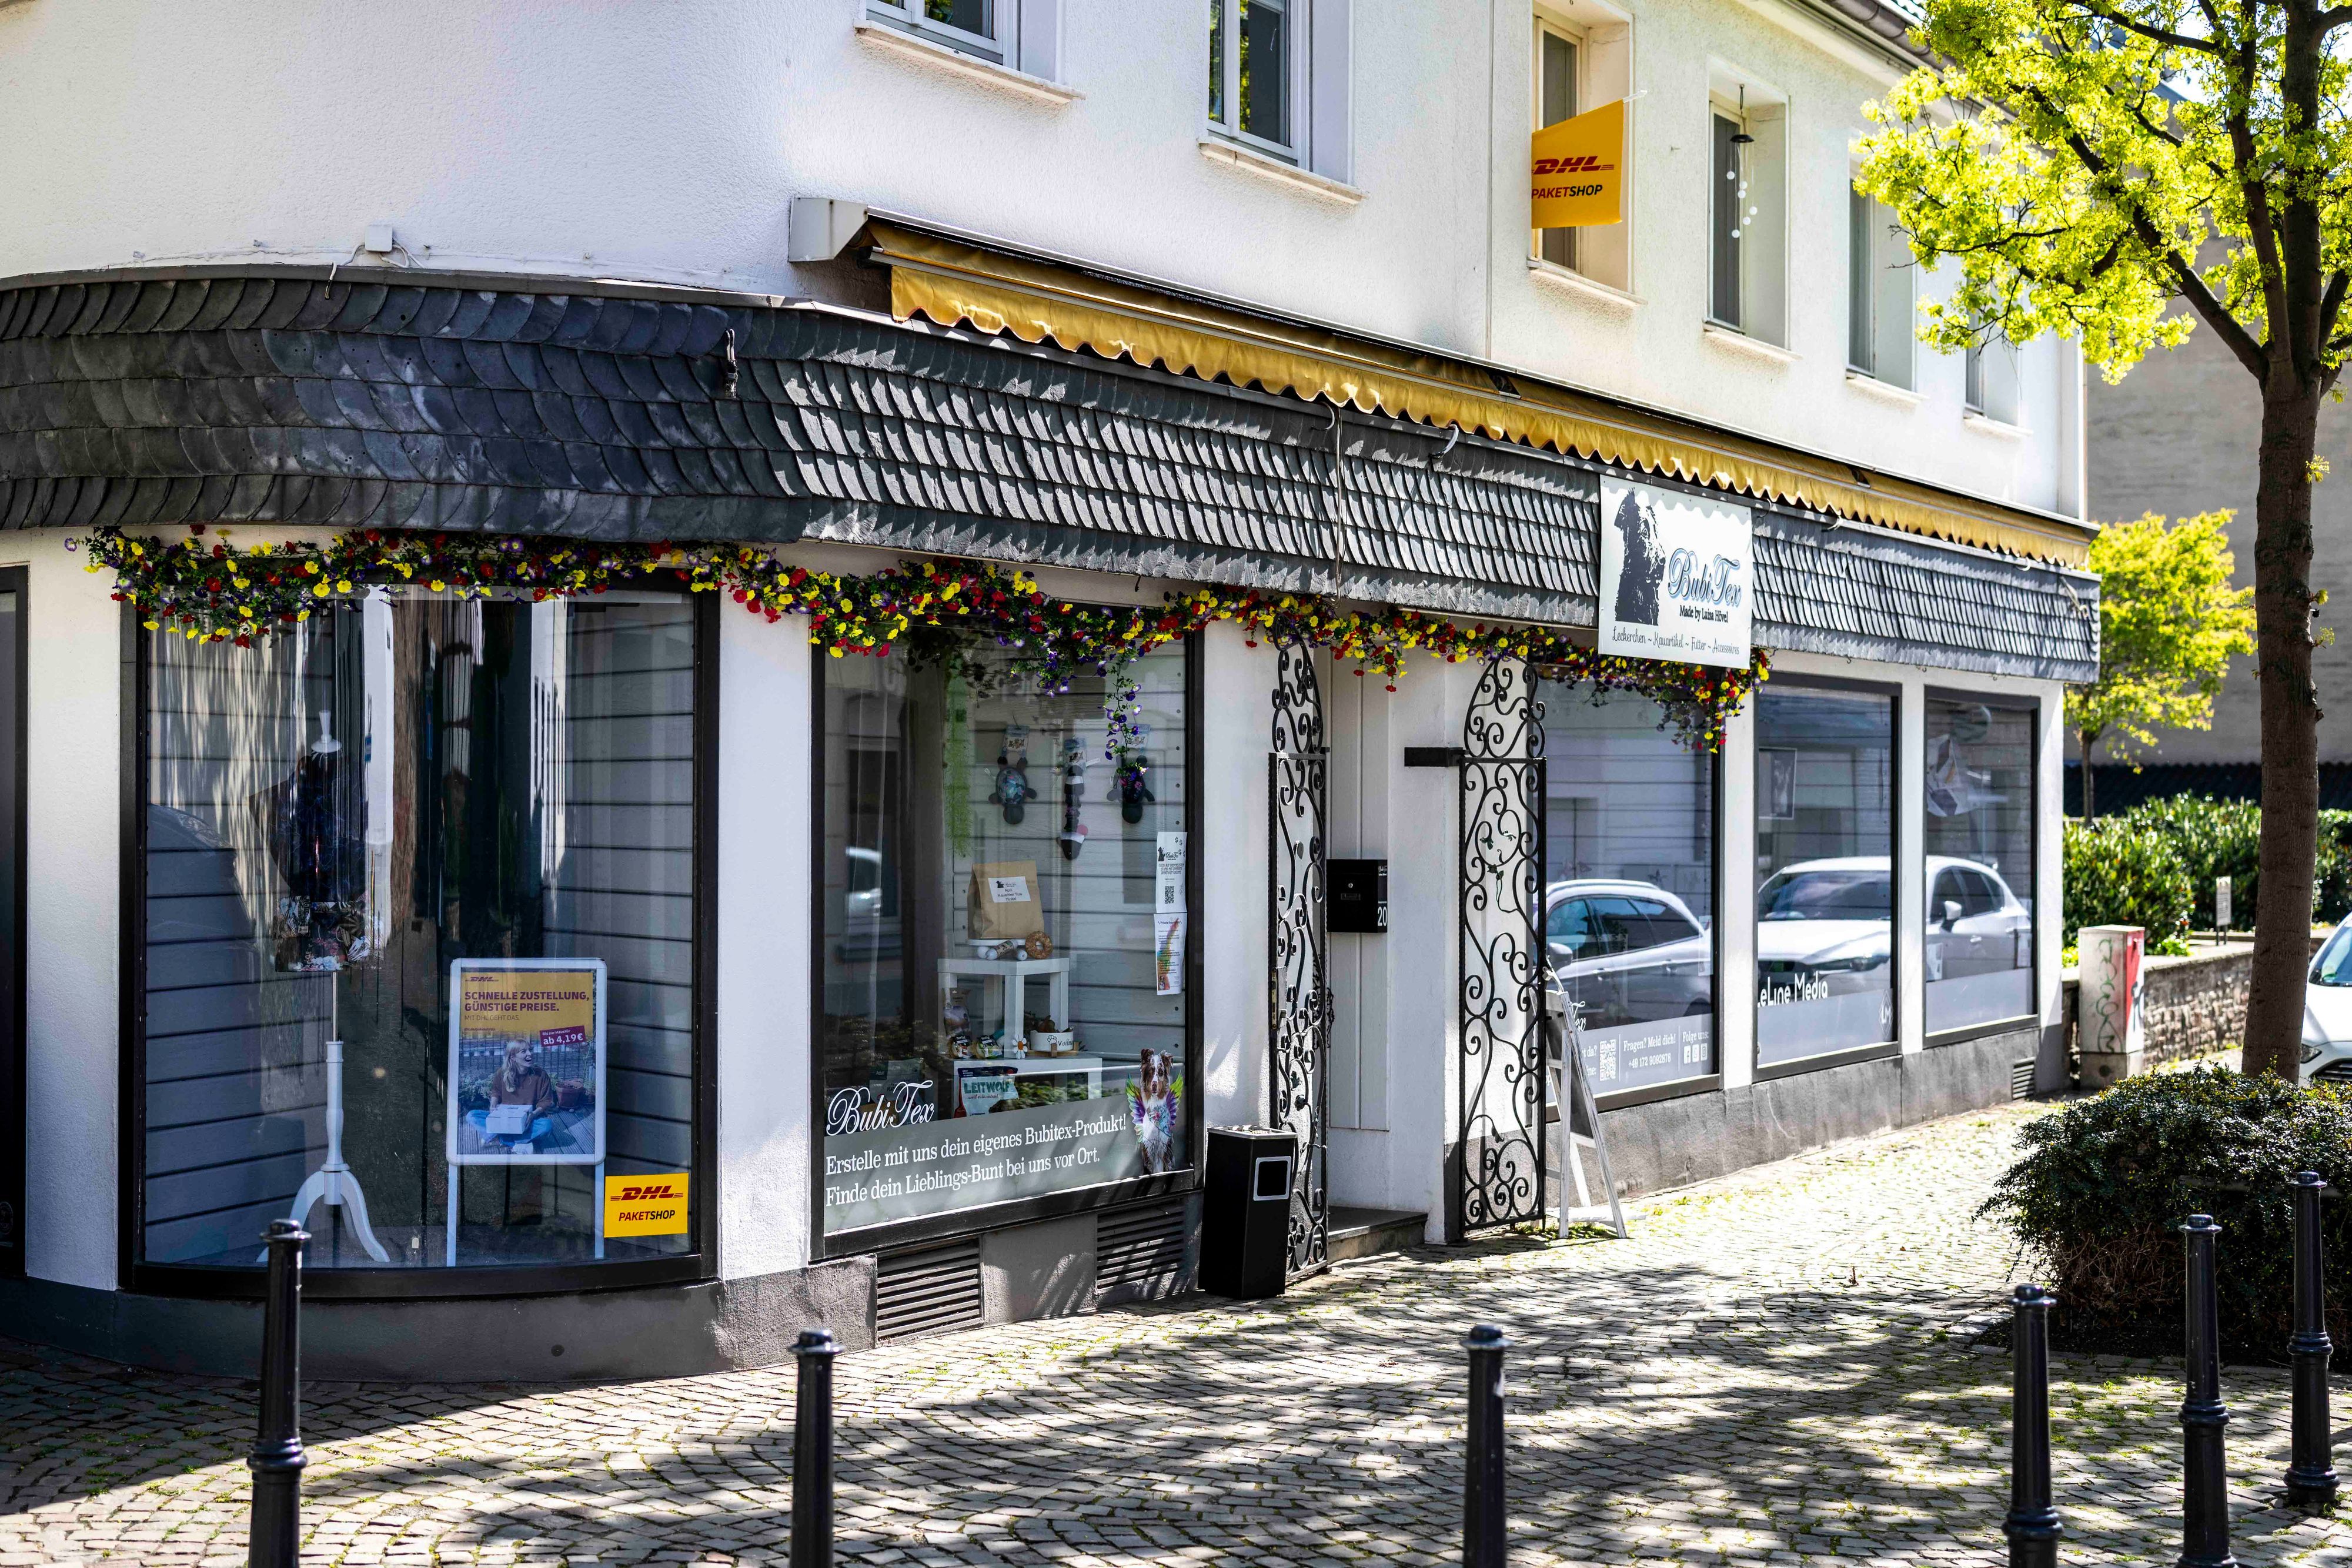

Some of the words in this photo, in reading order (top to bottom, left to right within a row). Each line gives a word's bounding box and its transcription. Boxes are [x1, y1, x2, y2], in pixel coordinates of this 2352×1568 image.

[1534, 156, 1601, 175] DHL
[1531, 184, 1603, 199] PAKETSHOP
[1680, 605, 1693, 618] Made
[1695, 606, 1701, 622] by
[1702, 608, 1714, 621] Luisa
[1715, 610, 1728, 623] Hövel
[1612, 626, 1646, 644] Leckerchen
[1653, 631, 1683, 648] Kauartikel
[1691, 637, 1706, 651] Futter
[1712, 638, 1739, 654] Accessoires
[1378, 906, 1388, 926] 20
[1795, 971, 1828, 1002] Media
[465, 991, 517, 1000] SCHNELLE
[520, 991, 590, 1001] ZUSTELLUNG,
[465, 1001, 517, 1011] GÜNSTIGE
[520, 1002, 560, 1011] PREISE.
[543, 1035, 554, 1045] ab
[556, 1033, 583, 1044] 4,19€
[1623, 1037, 1646, 1053] Fragen?
[1648, 1035, 1661, 1048] Meld
[1662, 1033, 1676, 1045] dich!
[1683, 1031, 1696, 1044] Folge
[1698, 1031, 1709, 1040] uns:
[1639, 1056, 1650, 1068] 172
[964, 1081, 1010, 1094] LEITWOLF
[826, 1149, 881, 1175] Erstelle
[884, 1146, 908, 1166] mit
[913, 1146, 937, 1162] uns
[941, 1137, 970, 1158] dein
[973, 1133, 1022, 1156] eigenes
[1025, 1113, 1126, 1145] Bubitex-Produkt!
[826, 1183, 867, 1206] Finde
[871, 1178, 902, 1200] dein
[906, 1162, 1004, 1193] Lieblings-Bunt
[1006, 1157, 1025, 1176] bei
[1028, 1157, 1051, 1173] uns
[1054, 1154, 1075, 1169] vor
[1077, 1147, 1100, 1165] Ort.
[621, 1185, 674, 1201] DHL
[619, 1210, 675, 1221] PAKETSHOP
